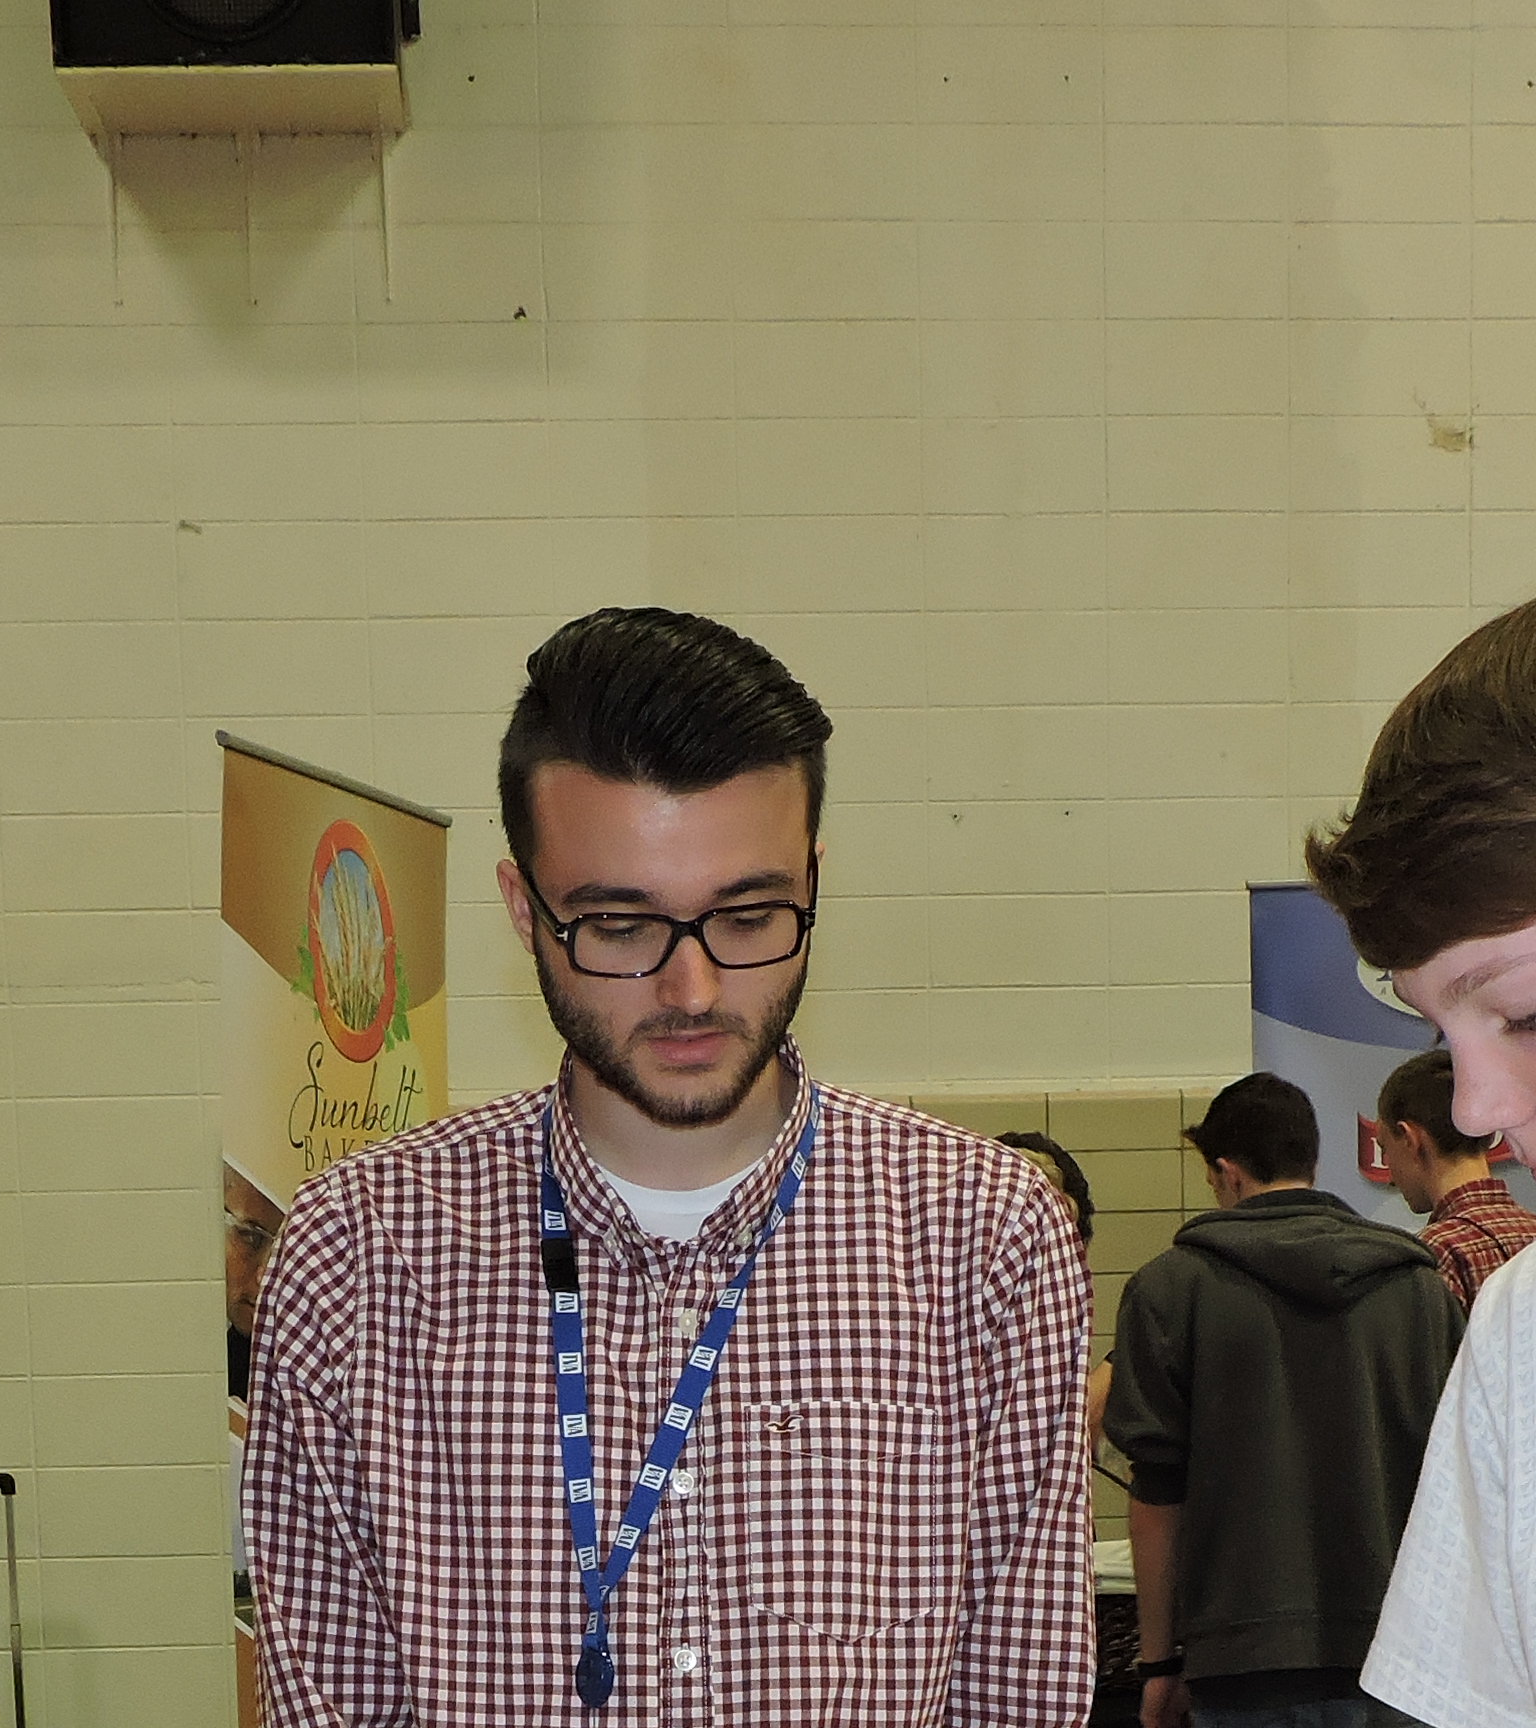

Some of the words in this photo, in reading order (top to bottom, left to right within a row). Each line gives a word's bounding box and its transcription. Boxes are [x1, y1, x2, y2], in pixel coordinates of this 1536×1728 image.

[288, 1041, 423, 1149] Sunbelt
[304, 1135, 373, 1172] BAK
[560, 1354, 580, 1373] TVA
[691, 1347, 716, 1369] TVA
[565, 1416, 585, 1436] TVA
[666, 1405, 691, 1427] TVA
[641, 1465, 666, 1488] TVA
[570, 1478, 590, 1502] TVA
[617, 1526, 639, 1548] TVA
[578, 1548, 595, 1570] TVA
